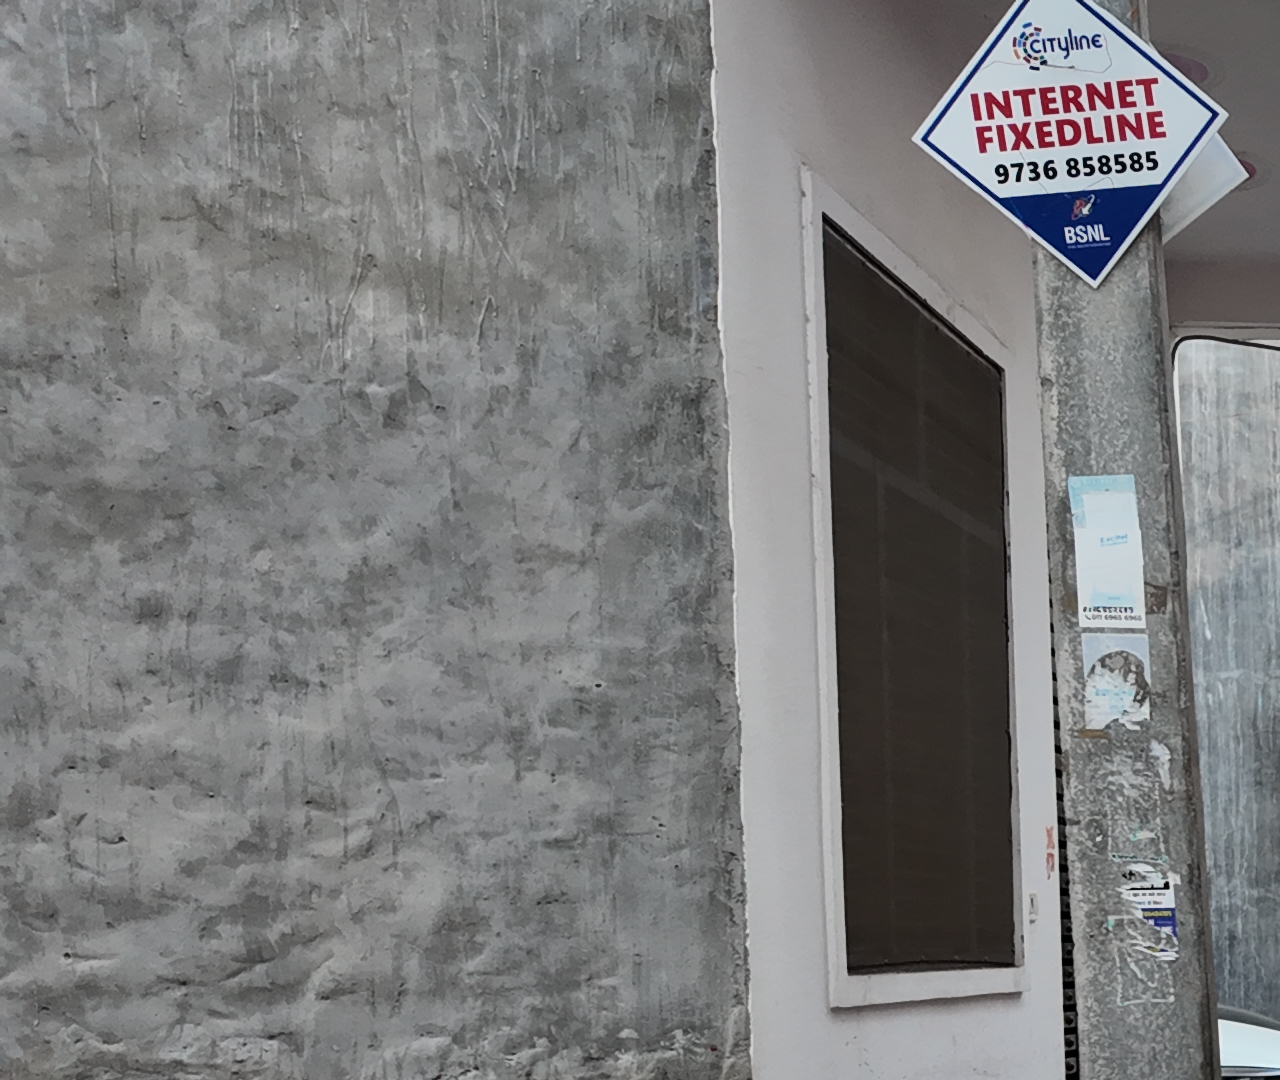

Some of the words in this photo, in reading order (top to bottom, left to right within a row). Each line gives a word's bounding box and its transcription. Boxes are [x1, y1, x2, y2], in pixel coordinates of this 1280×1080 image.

[970, 77, 1159, 121] INTERNET
[975, 111, 1167, 154] FIXEDLINE
[994, 160, 1058, 184] 9736
[1065, 151, 1159, 178] 858585
[1063, 223, 1111, 244] BSNL
